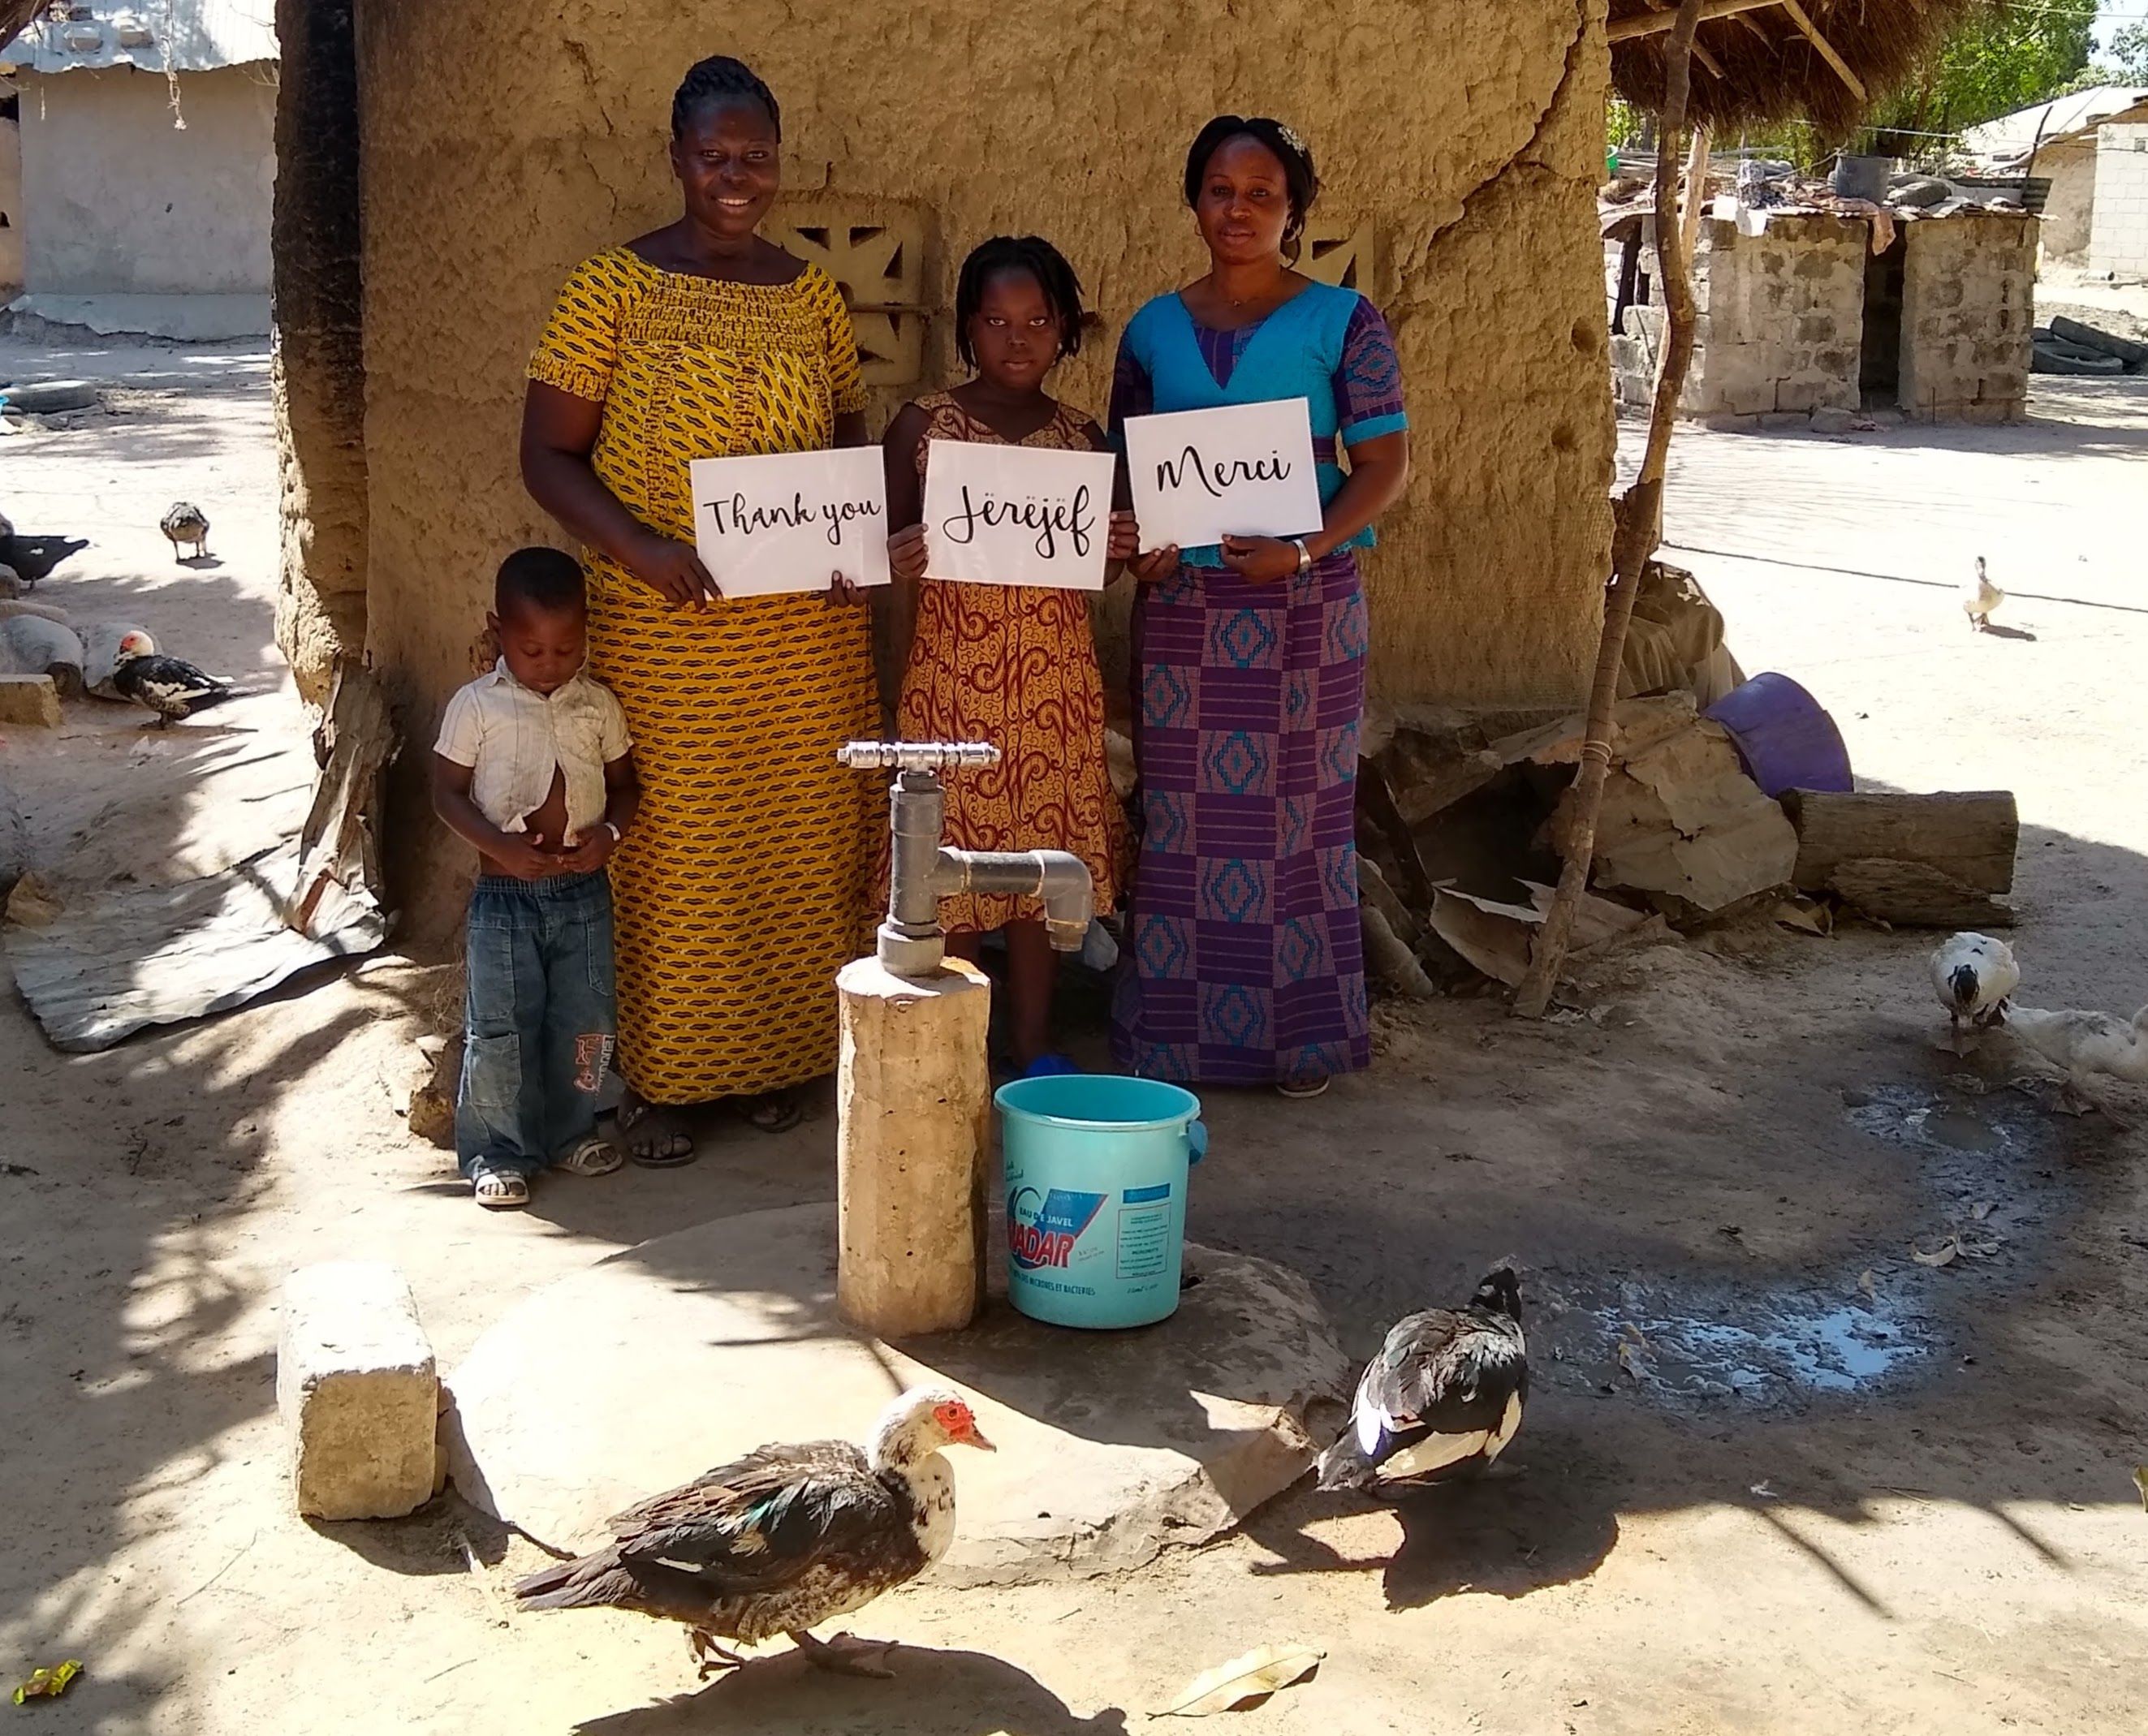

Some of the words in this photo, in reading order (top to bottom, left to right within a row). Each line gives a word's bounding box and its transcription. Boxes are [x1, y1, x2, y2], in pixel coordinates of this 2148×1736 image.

[1157, 446, 1292, 498] Merci
[703, 492, 817, 535] Thank
[822, 499, 882, 546] you
[942, 485, 1096, 559] Jërëjëf
[1020, 1207, 1033, 1218] EAU
[1033, 1212, 1045, 1221] DE
[1046, 1215, 1073, 1227] JAVEL
[1055, 1283, 1062, 1292] ET
